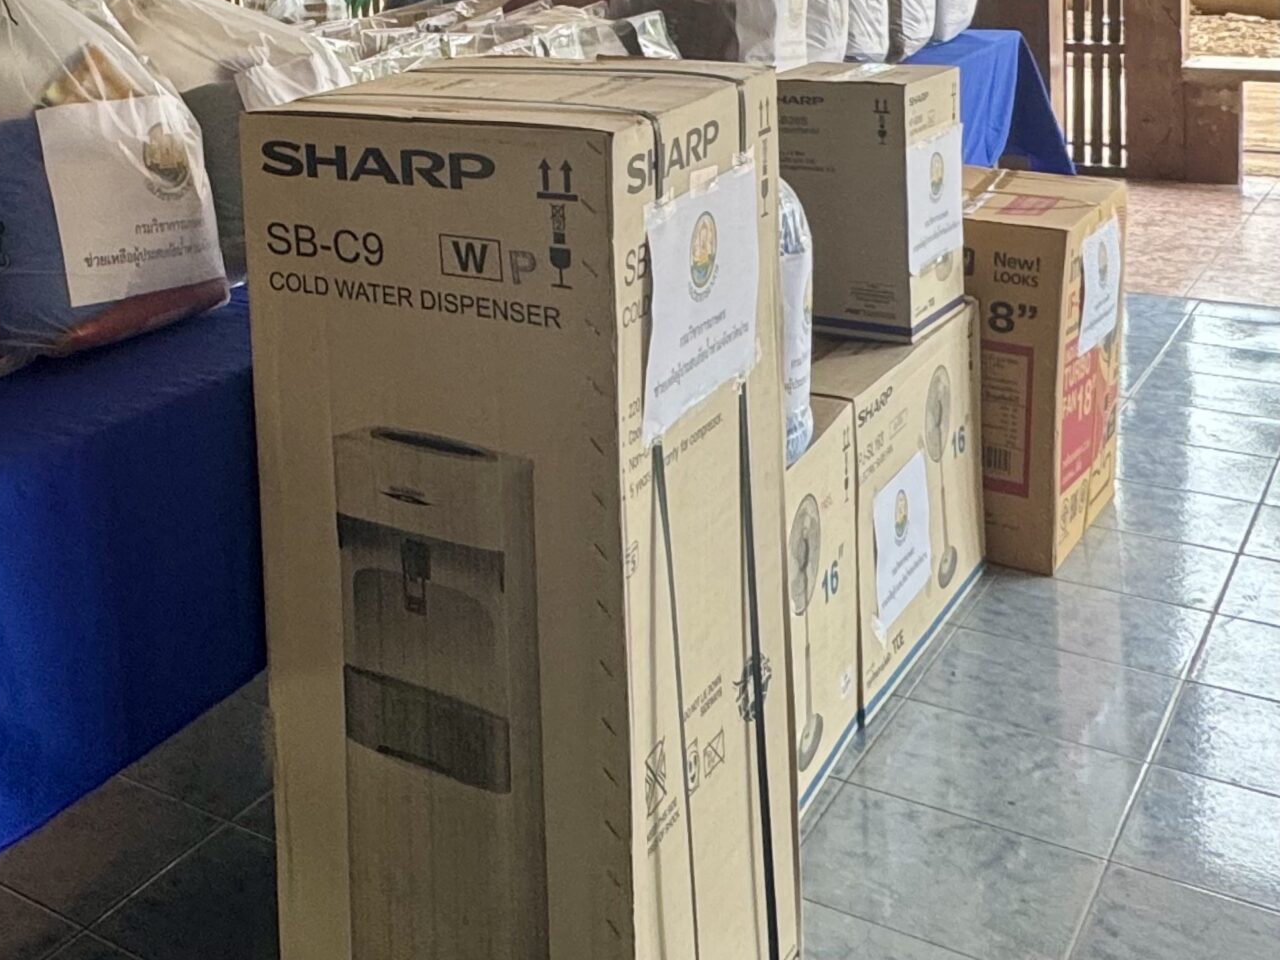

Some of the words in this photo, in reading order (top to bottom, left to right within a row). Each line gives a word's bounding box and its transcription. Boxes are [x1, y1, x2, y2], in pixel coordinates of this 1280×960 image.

[261, 140, 496, 190] SHARP
[627, 120, 720, 195] SHARP
[266, 222, 385, 266] SB-C9
[451, 240, 489, 275] W
[509, 249, 537, 286] P
[993, 251, 1042, 273] New!
[269, 270, 330, 297] COLD
[334, 278, 415, 309] WATER
[420, 290, 563, 330] DISPENSER
[993, 271, 1040, 289] LOOKS
[858, 385, 894, 429] SHARP
